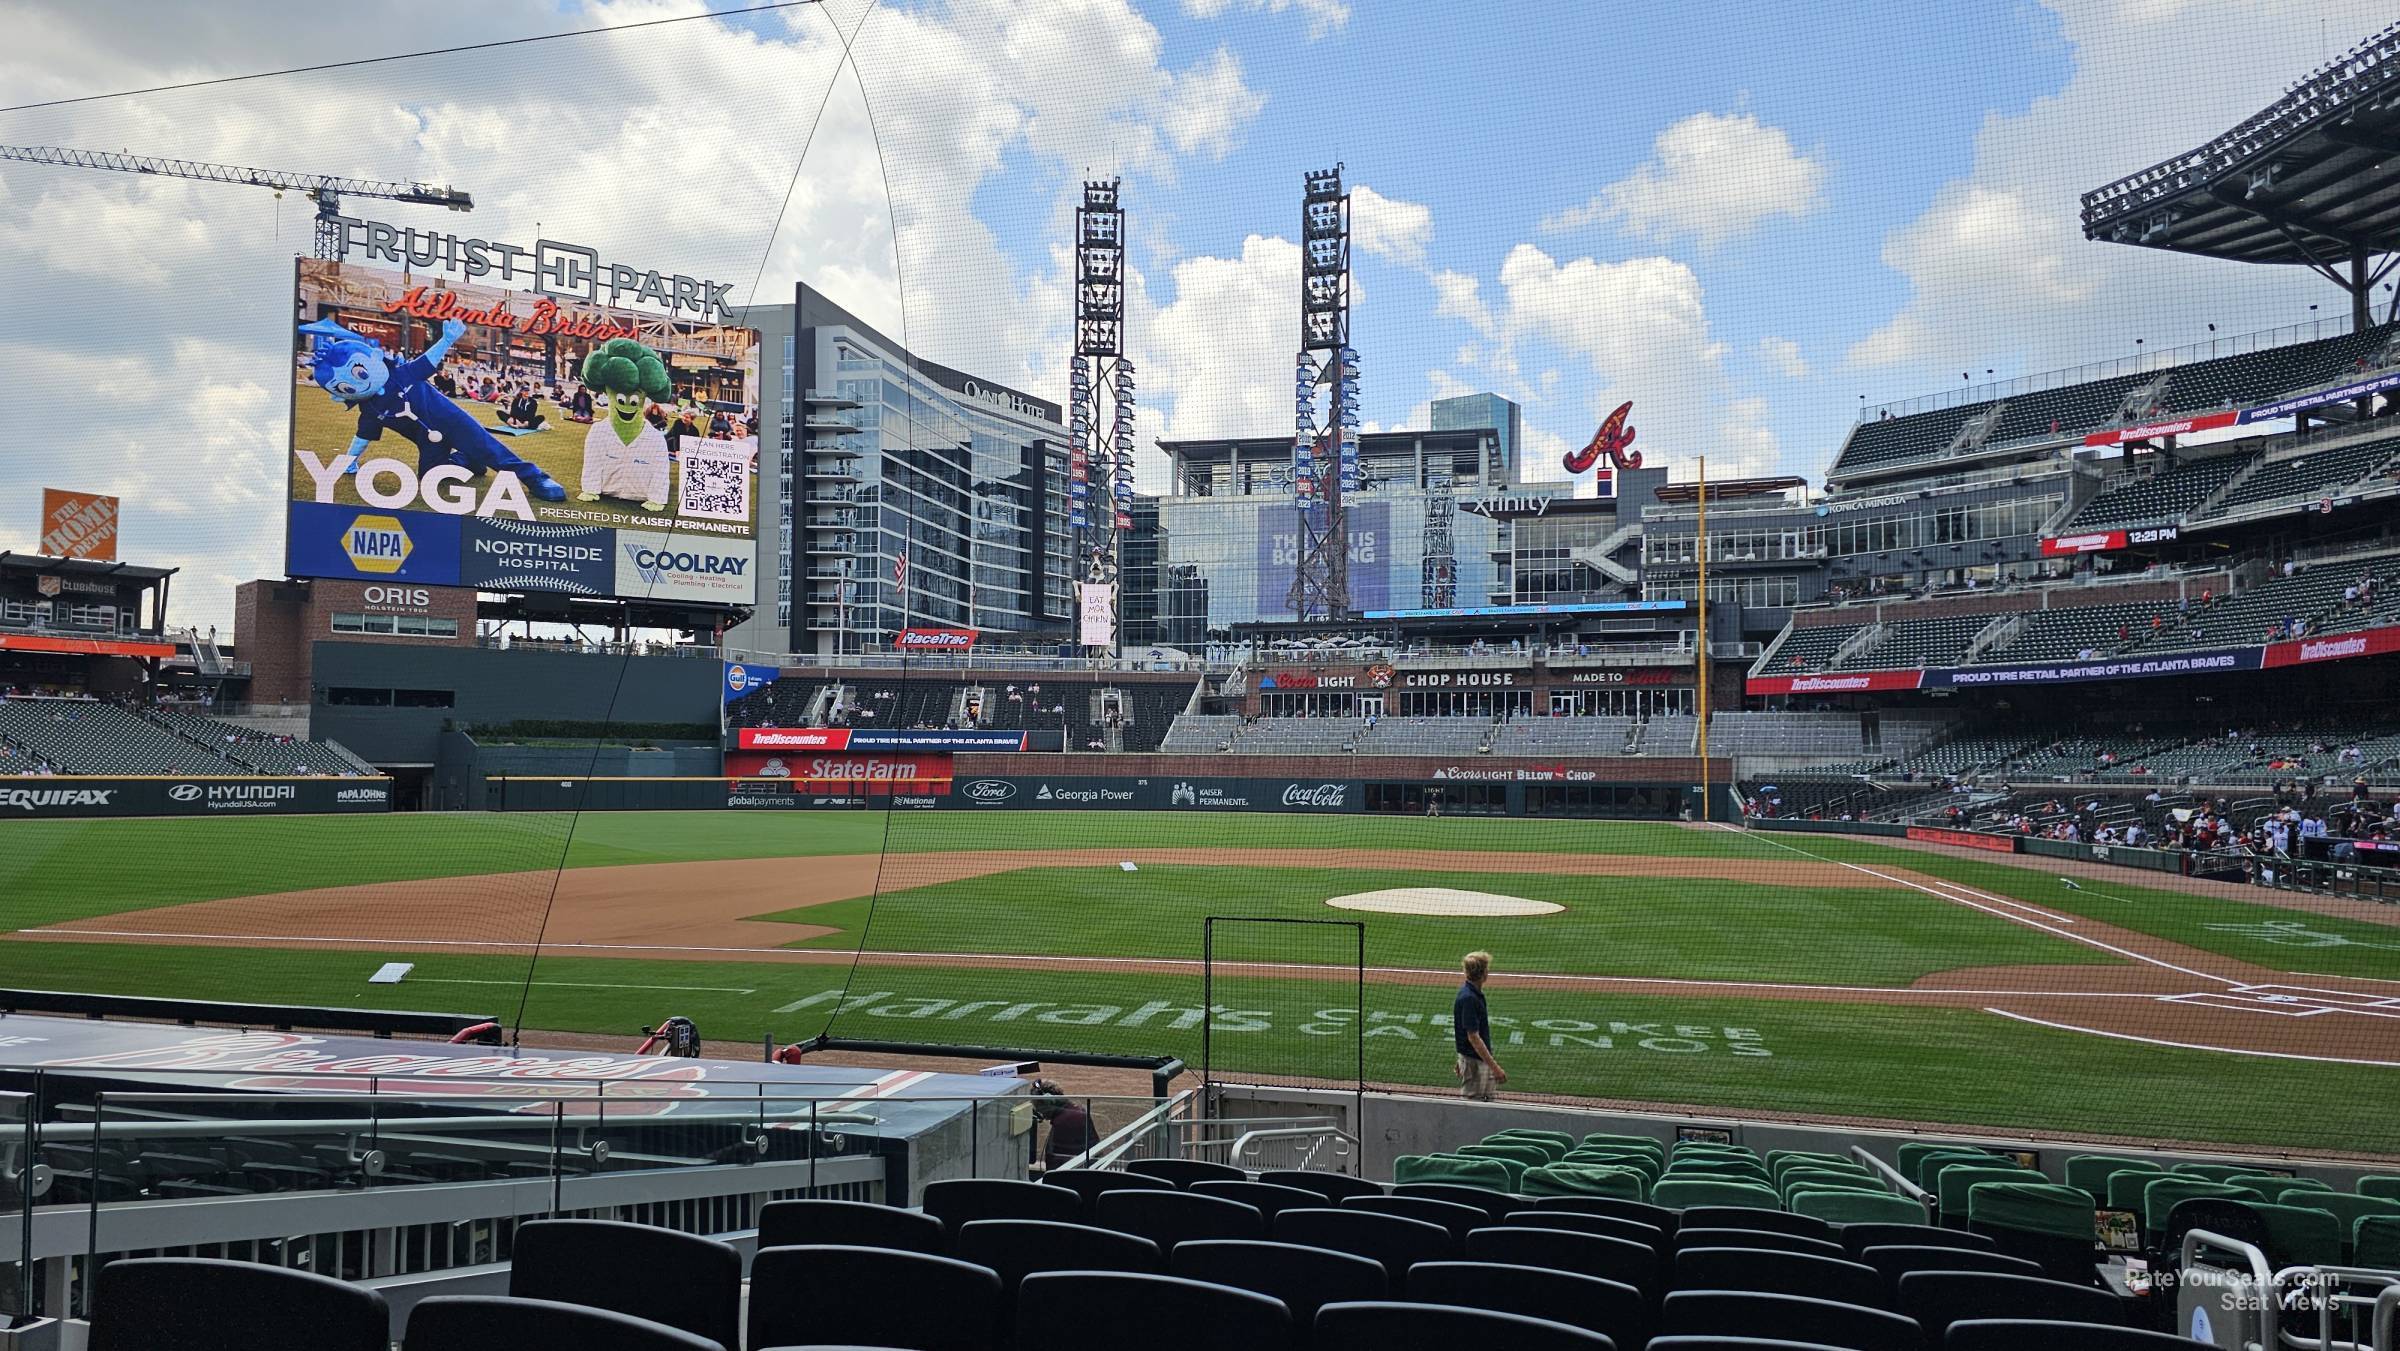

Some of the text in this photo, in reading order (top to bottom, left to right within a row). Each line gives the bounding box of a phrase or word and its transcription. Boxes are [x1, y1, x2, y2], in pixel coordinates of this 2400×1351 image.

[329, 215, 735, 318] TRUIST PARK
[384, 286, 516, 329] Atlanta
[2250, 377, 2398, 419] PROUD TIRE RETAIL PARTNER OF THE
[2119, 421, 2193, 440] TireDiscounters
[295, 449, 537, 521] YOGA
[50, 499, 82, 525] THE
[1473, 496, 1551, 517] xfinity
[1830, 495, 1906, 514] KONICA MINOLTA
[41, 496, 117, 556] HOME
[540, 507, 751, 535] PRESENTED BY KAISER PERMANENTE
[2129, 528, 2177, 543] 12:29 PM
[353, 530, 401, 558] NAPA
[475, 539, 603, 561] NORTHSIDE
[499, 558, 579, 572] HOSPITAL
[635, 549, 748, 576] COOLRAY
[667, 572, 726, 583] Cooling Heating
[673, 580, 743, 590] Plumbing Electrical
[364, 587, 430, 606] ORIS
[901, 632, 969, 645] RaceTrac
[2300, 638, 2367, 660] TireDiscounters
[1952, 655, 2235, 683] PROUD TIRE RETAIL PARTNER OF THE ATLANTA BRAVES
[1317, 677, 1355, 687] LIGHT
[1407, 673, 1513, 686] CHOP HOUSE
[1573, 674, 1606, 682] MADE
[1608, 673, 1623, 682] TO
[1791, 677, 1871, 690] TireDiscounters
[753, 733, 828, 745] TireDiscounters
[810, 759, 916, 779] StateFarm
[1448, 767, 1481, 780] Coors
[1483, 770, 1513, 780] LIGHT
[1517, 769, 1553, 780] BELOW
[1567, 770, 1596, 780] CHOP
[208, 786, 295, 799] HYUNDAI
[972, 782, 1007, 797] Ford
[1055, 789, 1133, 801] Georgia Power
[1200, 789, 1223, 797] KAISER
[0, 789, 112, 810] EQUIFAX
[208, 801, 276, 809] HyundaiUSA.com
[728, 796, 795, 807] globalpayments
[903, 797, 936, 805] National
[1200, 798, 1249, 806] PERMANENTE
